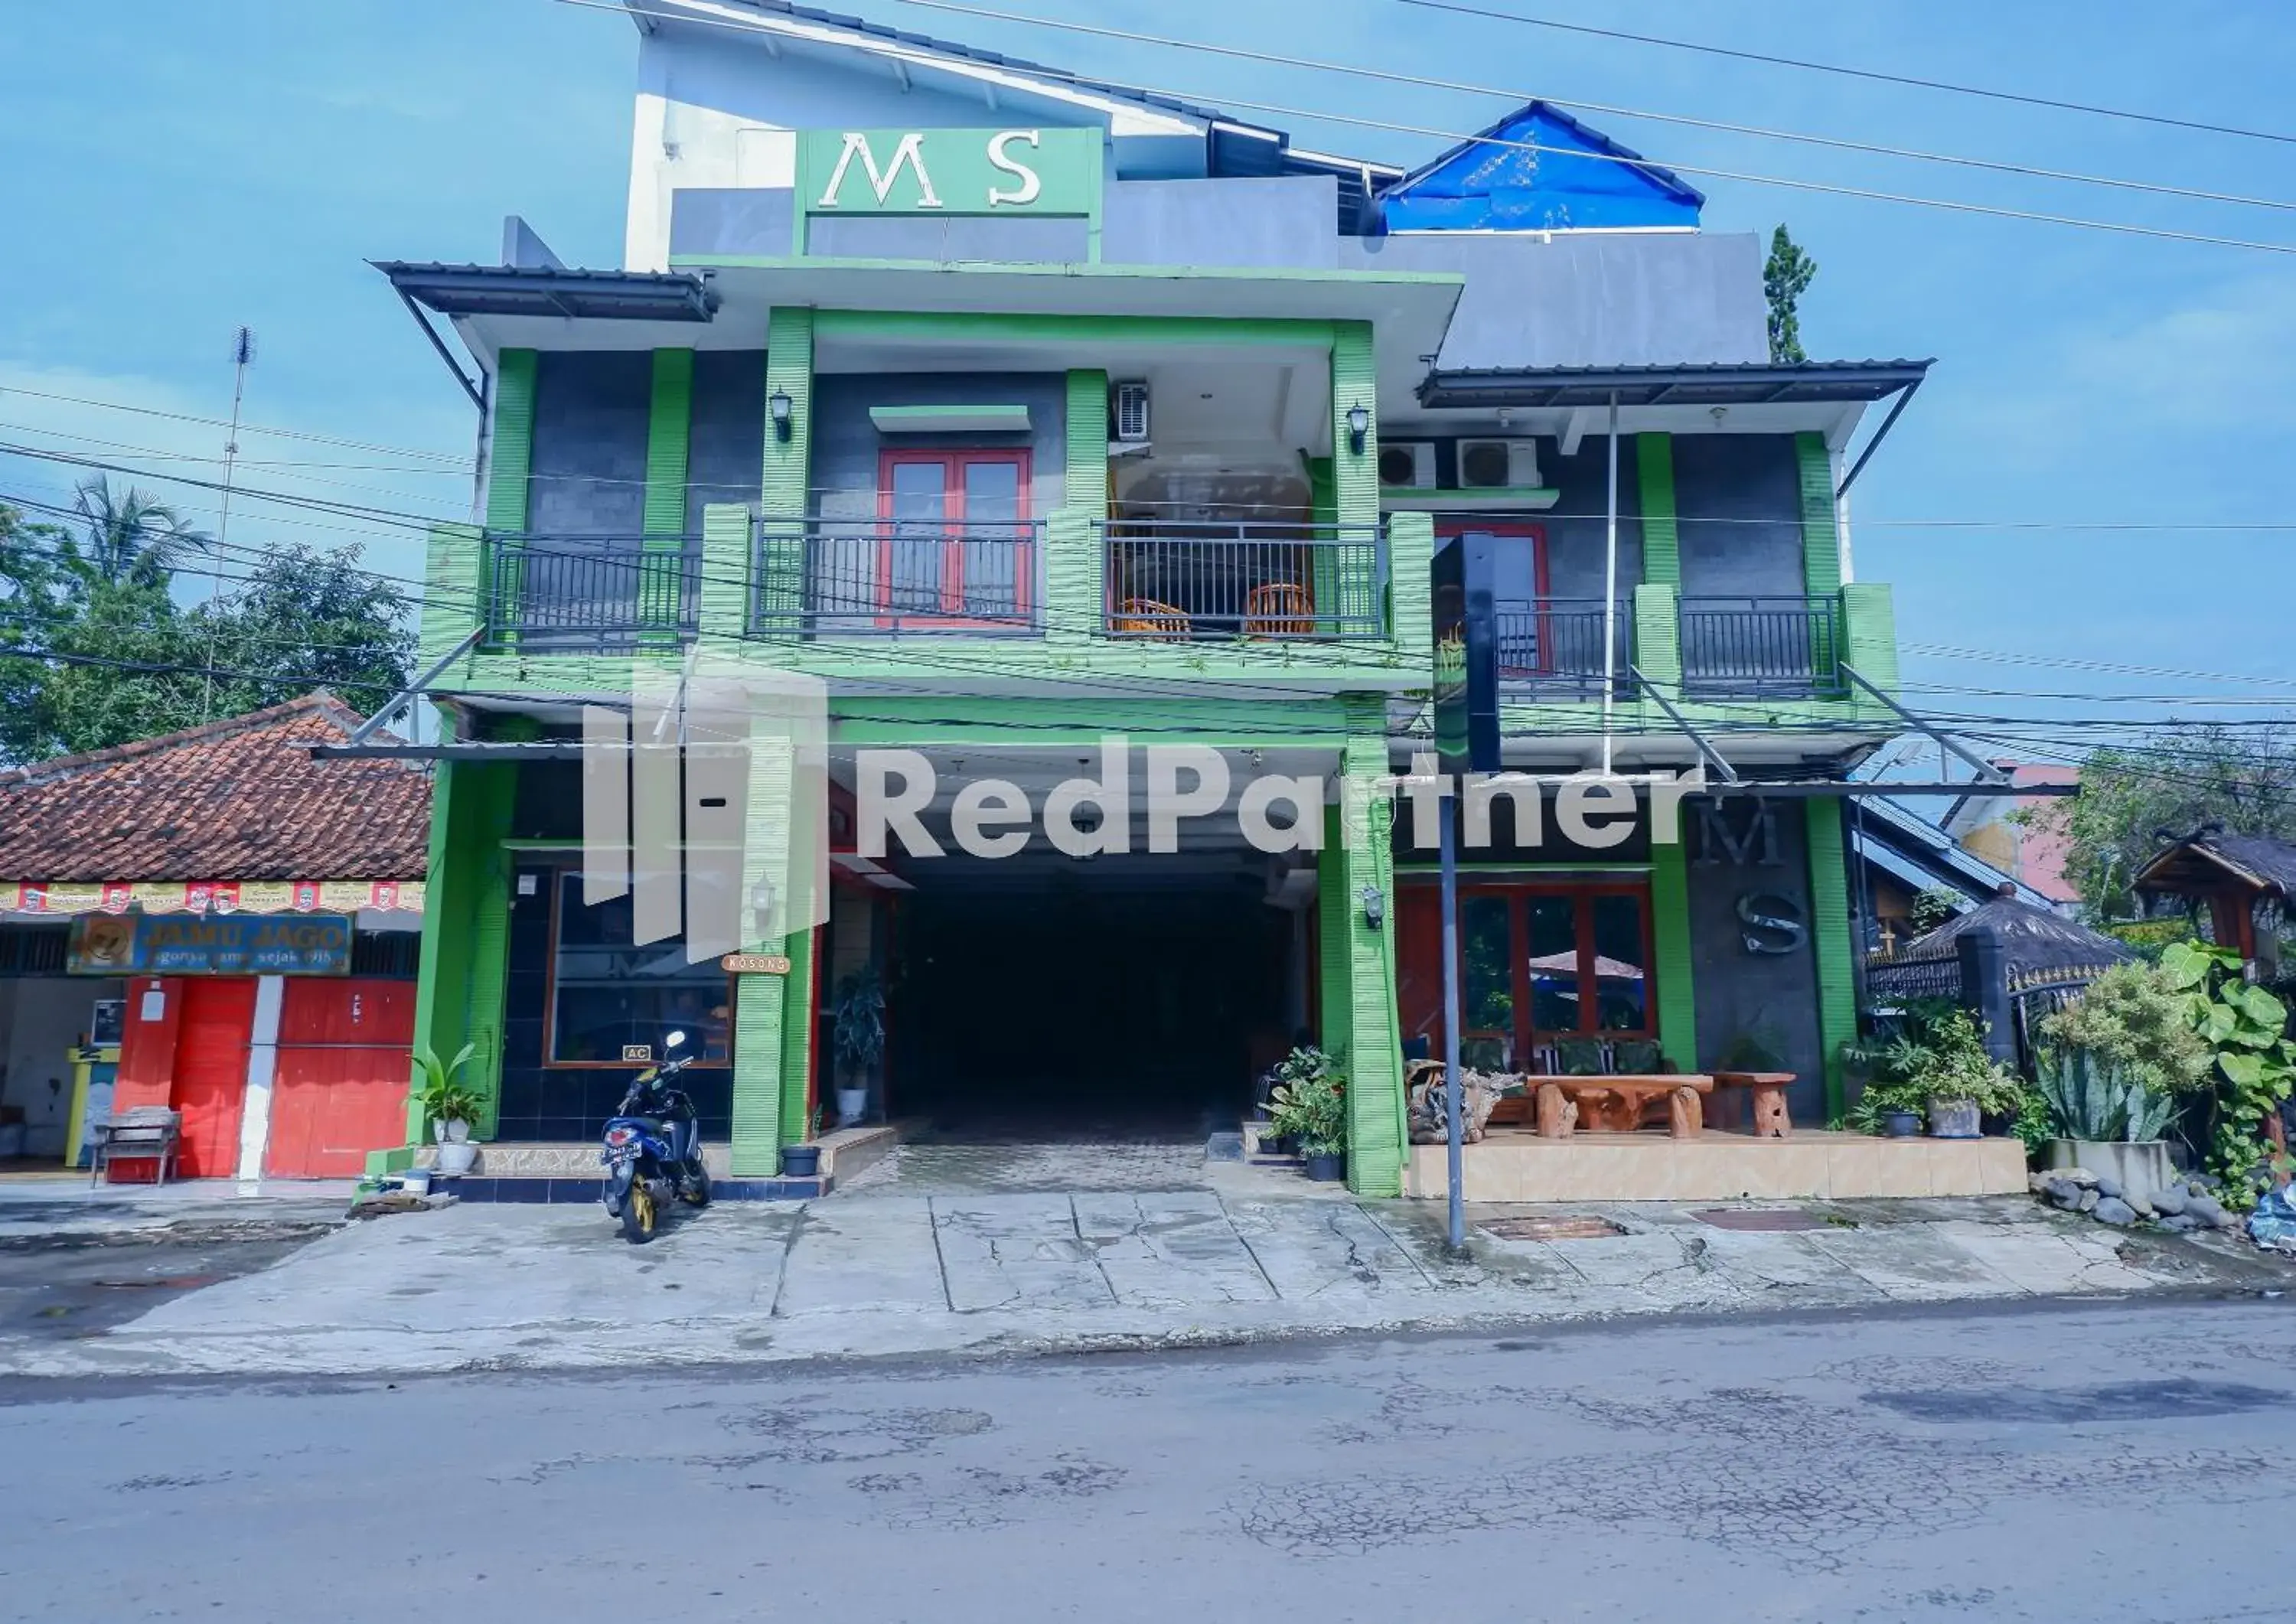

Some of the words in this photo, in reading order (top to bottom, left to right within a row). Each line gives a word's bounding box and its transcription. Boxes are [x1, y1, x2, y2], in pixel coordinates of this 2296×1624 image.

[818, 132, 943, 207] M
[987, 129, 1041, 207] S
[1691, 801, 1786, 868] M
[144, 924, 244, 947] JAMU
[251, 925, 344, 948] JAGO
[729, 957, 784, 970] KOSONG
[628, 1048, 647, 1058] AC
